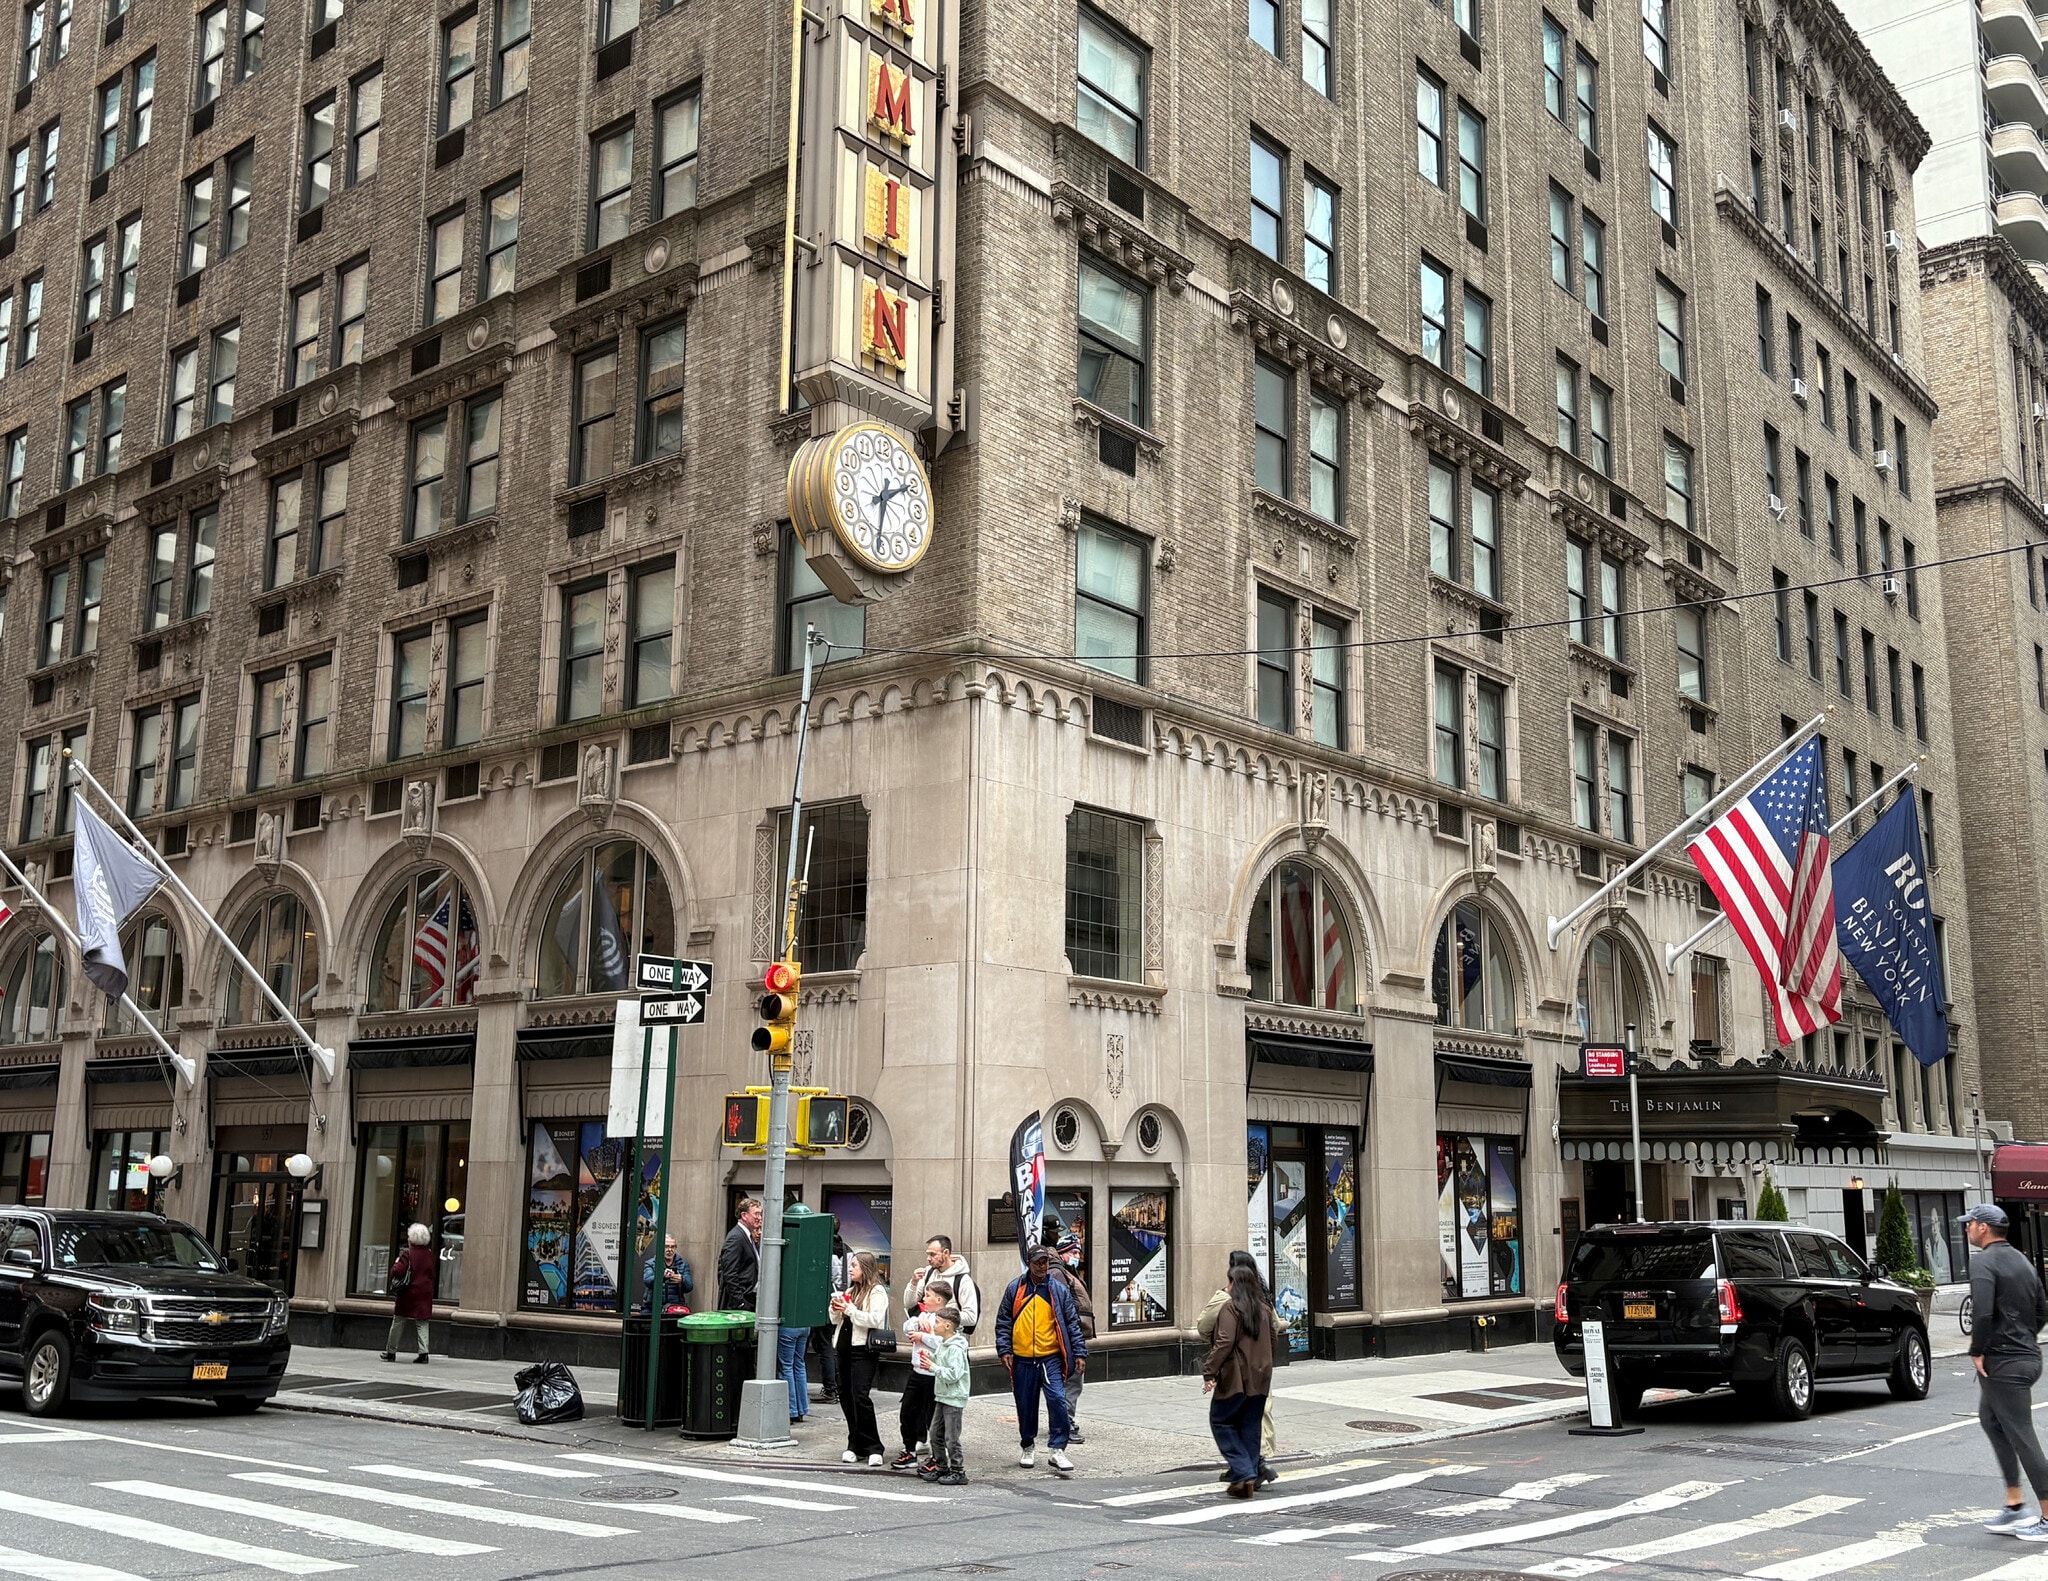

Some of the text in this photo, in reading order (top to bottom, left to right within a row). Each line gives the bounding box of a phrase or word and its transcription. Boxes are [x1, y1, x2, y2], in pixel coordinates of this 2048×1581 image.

[1885, 899, 1931, 966] SONESTA
[1851, 897, 1933, 1003] BENJAMIN
[1842, 915, 1911, 1007] NEW YORK
[649, 966, 702, 984] ONE WAY
[649, 1001, 696, 1017] ONE WAY
[1609, 1099, 1721, 1113] TH BENJAMIN
[597, 1222, 620, 1230] SONEST
